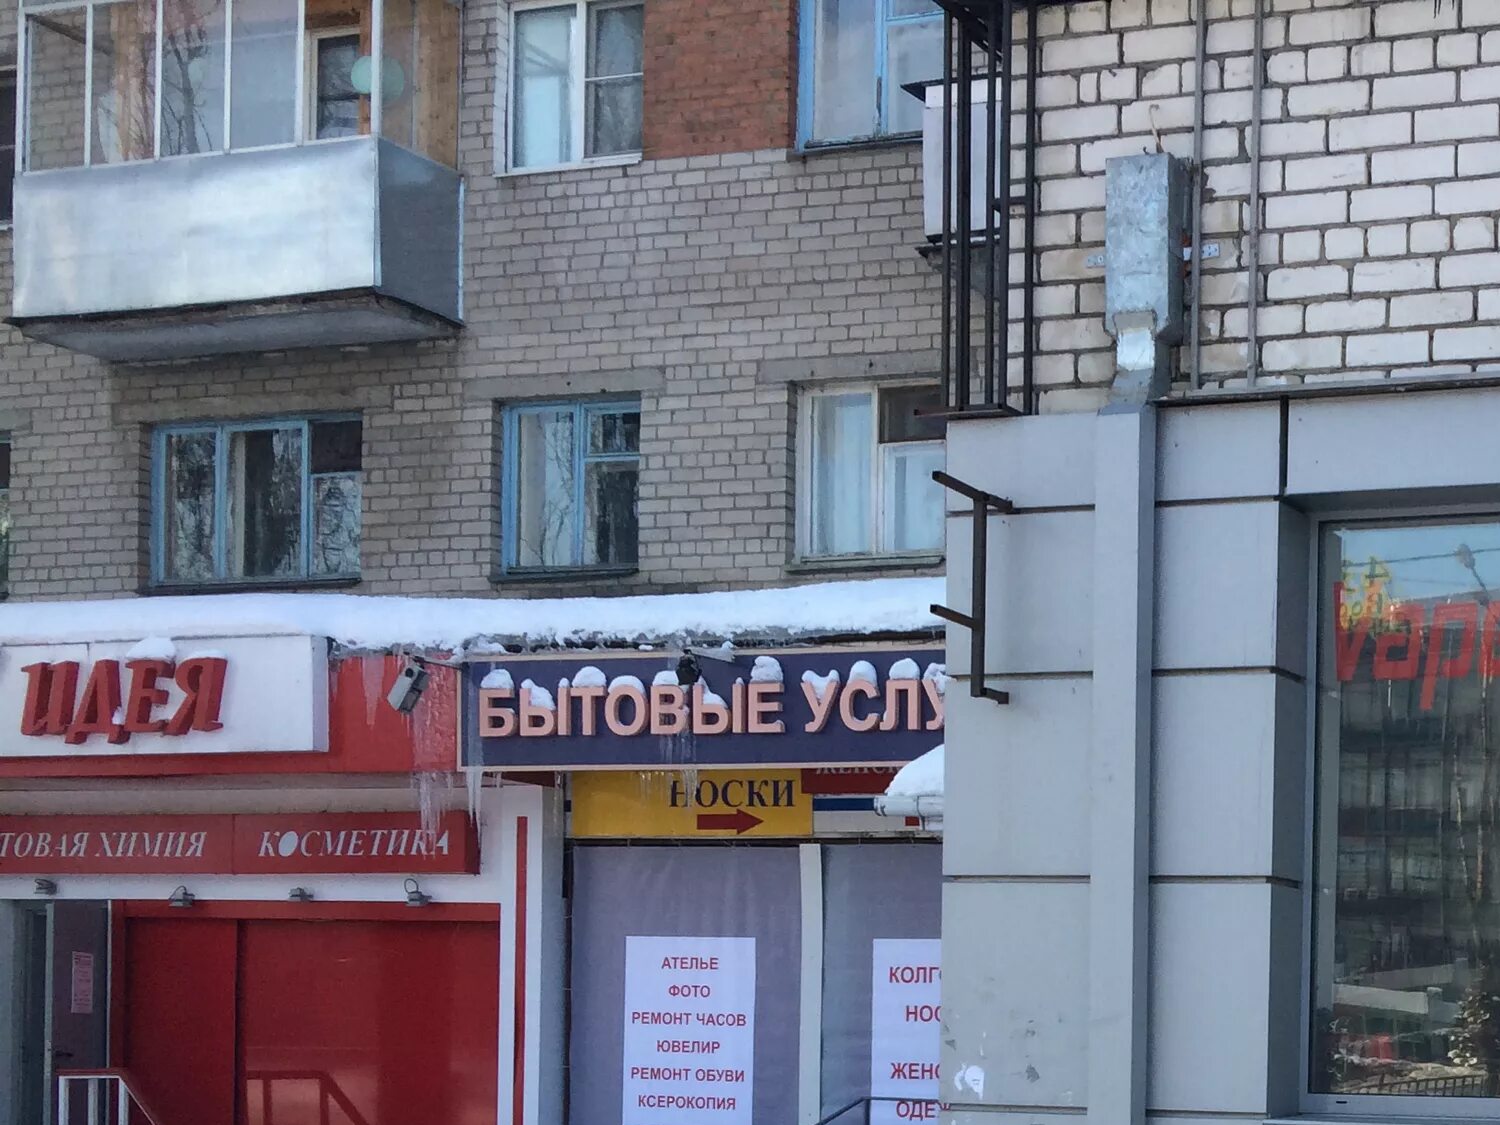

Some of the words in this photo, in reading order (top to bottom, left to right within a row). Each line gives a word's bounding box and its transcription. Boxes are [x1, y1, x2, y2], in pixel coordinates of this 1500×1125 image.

[19, 656, 229, 745] ИДЕЯ
[478, 679, 787, 738] БЫТОВЫЕ
[669, 778, 796, 808] НОСКИ
[0, 831, 90, 858] ТОВАЯ
[95, 831, 207, 858] ХИМИЯ
[258, 830, 450, 858] КОСМЕТИКА
[661, 956, 719, 970] АТЕЛЬЕ
[889, 966, 942, 984] КОЛГ
[668, 984, 711, 998] ФОТО
[631, 1011, 692, 1025] РЕМОНТ
[696, 1012, 747, 1027] ЧАСОВ
[656, 1040, 721, 1054] ЮВЕЛИР
[630, 1067, 692, 1081] РЕМОНТ
[695, 1068, 745, 1083] ОБУВИ
[637, 1095, 737, 1110] КСЕРОКОПИЯ
